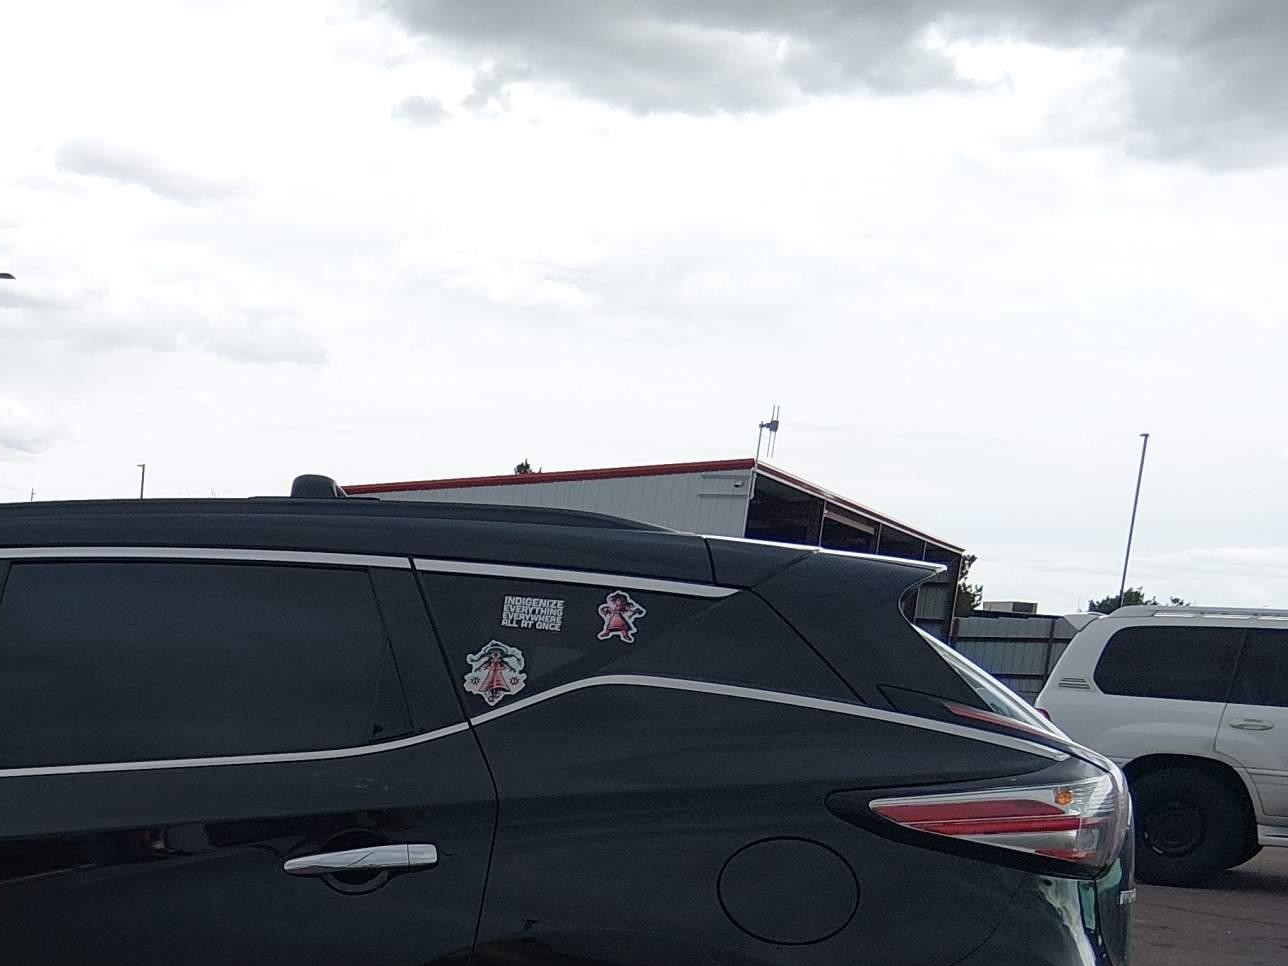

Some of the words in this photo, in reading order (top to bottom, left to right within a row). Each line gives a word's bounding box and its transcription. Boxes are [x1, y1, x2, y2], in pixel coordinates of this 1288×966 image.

[504, 595, 565, 609] INDIGENIZE
[503, 604, 563, 616] EVERYTHING
[502, 611, 563, 623] EVERYWHERE
[501, 619, 519, 627] ALL
[520, 620, 534, 628] AT
[535, 621, 561, 631] ONCE
